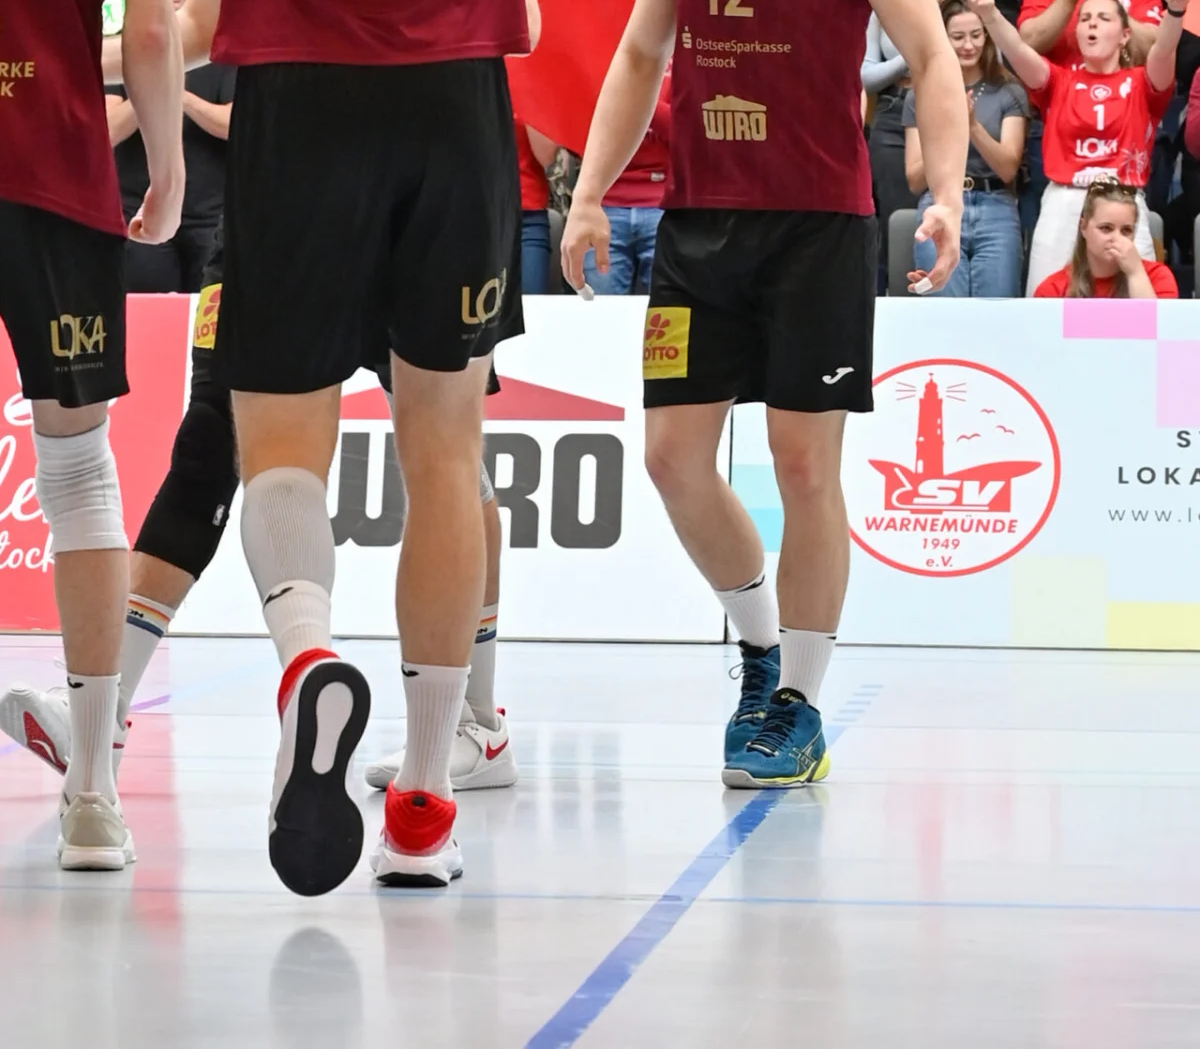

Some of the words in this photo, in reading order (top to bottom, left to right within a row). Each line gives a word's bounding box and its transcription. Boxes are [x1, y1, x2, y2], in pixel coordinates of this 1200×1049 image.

[696, 38, 792, 54] OstseeSparkasse
[696, 55, 737, 69] Rostock
[1093, 104, 1105, 131] 1
[702, 110, 767, 142] WIRO
[196, 322, 217, 340] LOT
[643, 346, 679, 362] OTTO
[334, 432, 624, 549] WRO
[1108, 507, 1200, 523] www.l
[865, 514, 1018, 534] WARNEMÜNDE
[923, 538, 960, 550] 1949
[926, 555, 953, 567] e.V.
